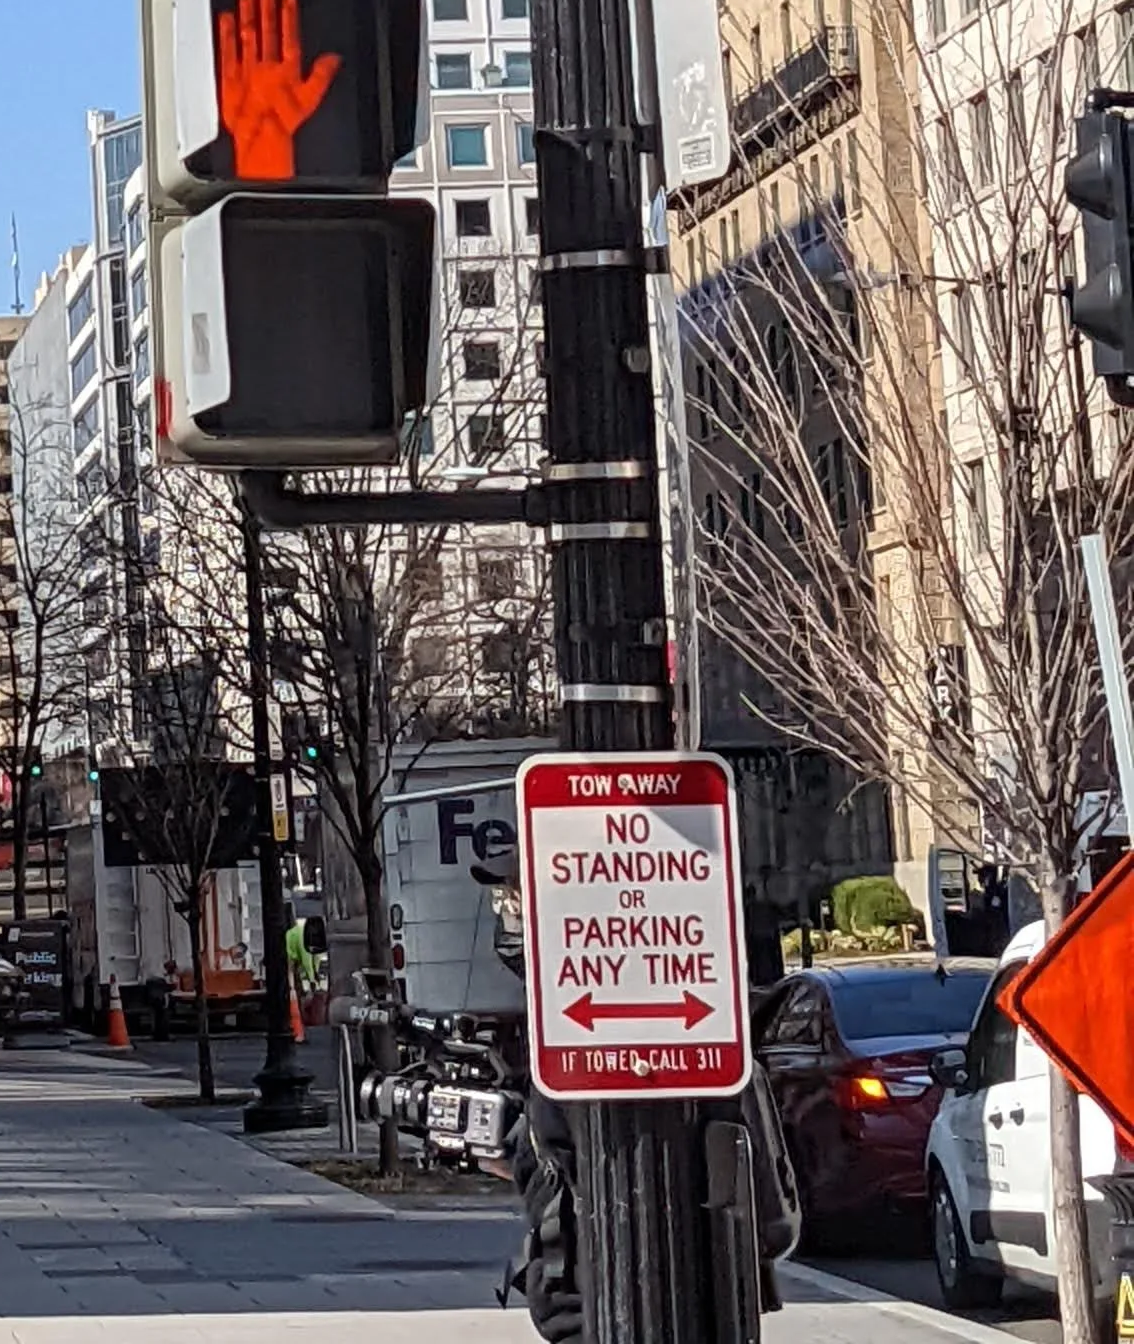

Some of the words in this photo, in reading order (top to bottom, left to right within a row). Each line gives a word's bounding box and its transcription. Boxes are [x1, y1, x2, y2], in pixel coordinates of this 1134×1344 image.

[568, 774, 612, 797] TOW
[617, 774, 681, 795] AWAY
[605, 813, 650, 845] NO
[551, 849, 710, 885] STANDING
[619, 889, 646, 909] OR
[563, 914, 704, 949] PARKING
[16, 951, 57, 964] Public
[558, 954, 626, 987] ANY
[642, 953, 718, 985] TIME
[561, 1051, 577, 1072] IF
[585, 1049, 641, 1072] TOWED
[649, 1049, 689, 1071] CALL
[696, 1047, 721, 1070] 311
